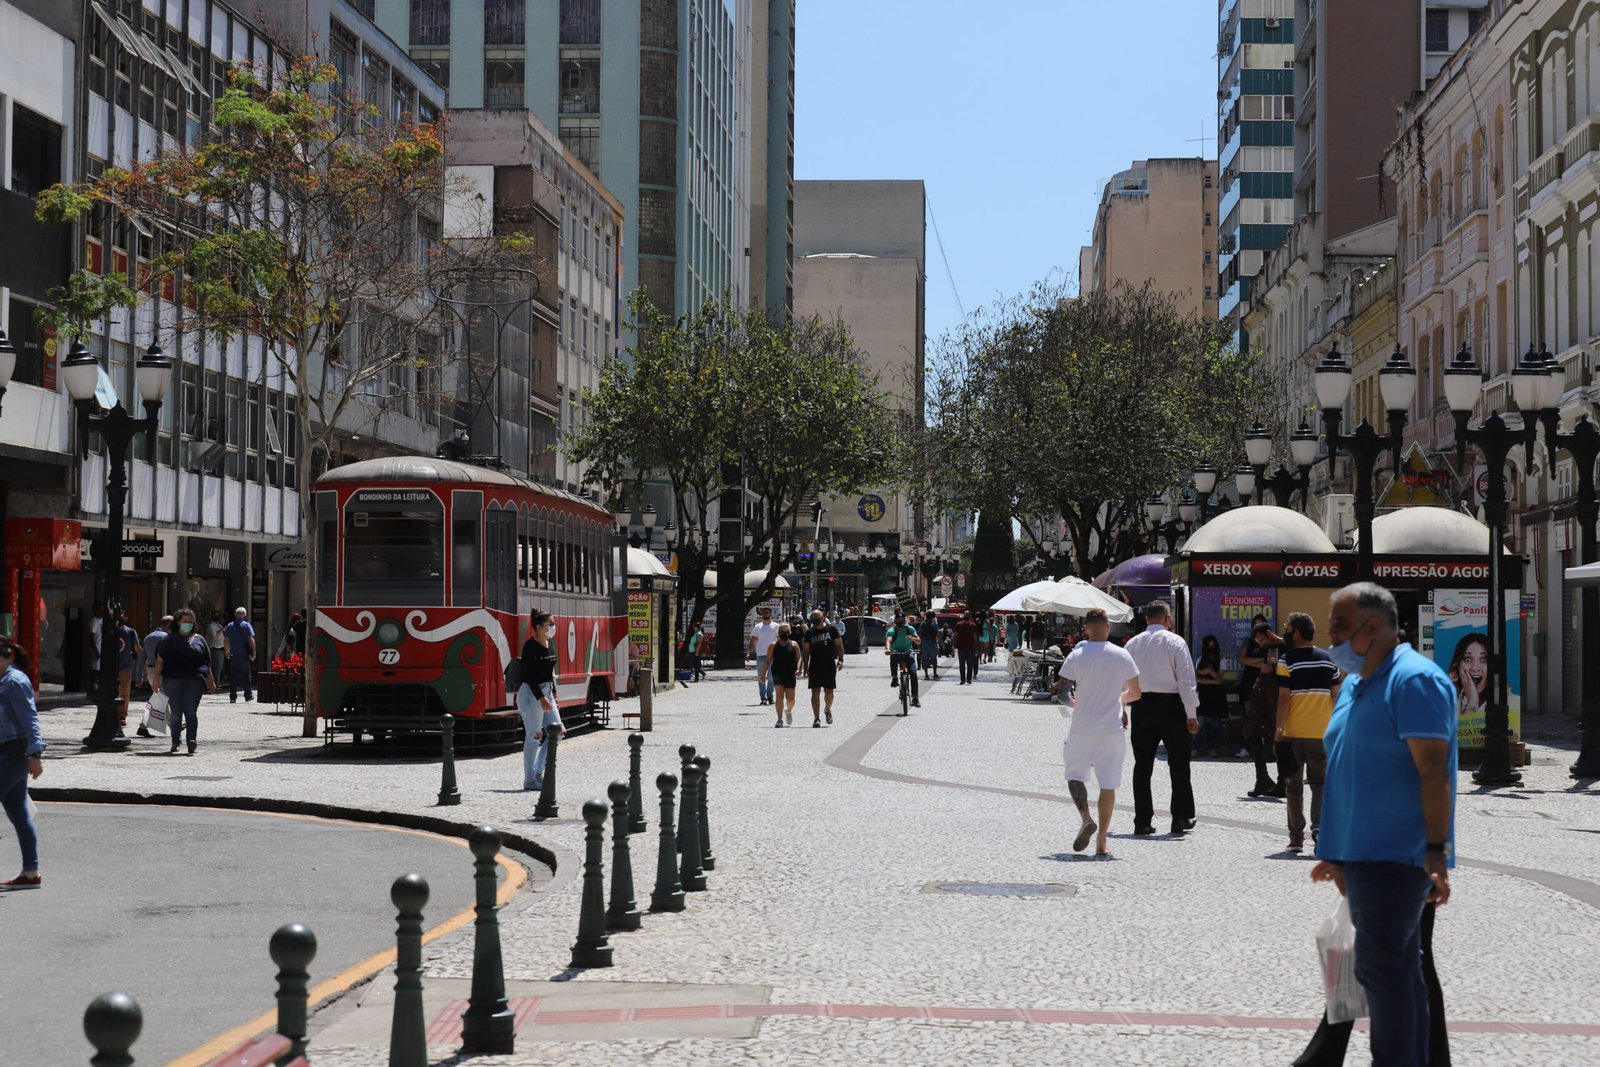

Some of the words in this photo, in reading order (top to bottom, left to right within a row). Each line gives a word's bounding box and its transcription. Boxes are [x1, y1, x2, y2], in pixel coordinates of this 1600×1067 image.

[359, 493, 392, 501] BONDINHO
[403, 493, 430, 501] LEITURA
[268, 547, 307, 563] Cam
[1203, 563, 1252, 576] XEROX
[1284, 562, 1339, 577] CÓPIAS
[1373, 563, 1448, 578] MPRESSÃO
[1451, 565, 1489, 578] AGOR
[628, 593, 648, 602] OÇÃO
[1224, 597, 1265, 605] ECONOMIZE
[1220, 605, 1272, 620] TEMPO
[1463, 606, 1488, 615] Panfl
[381, 651, 397, 662] 77
